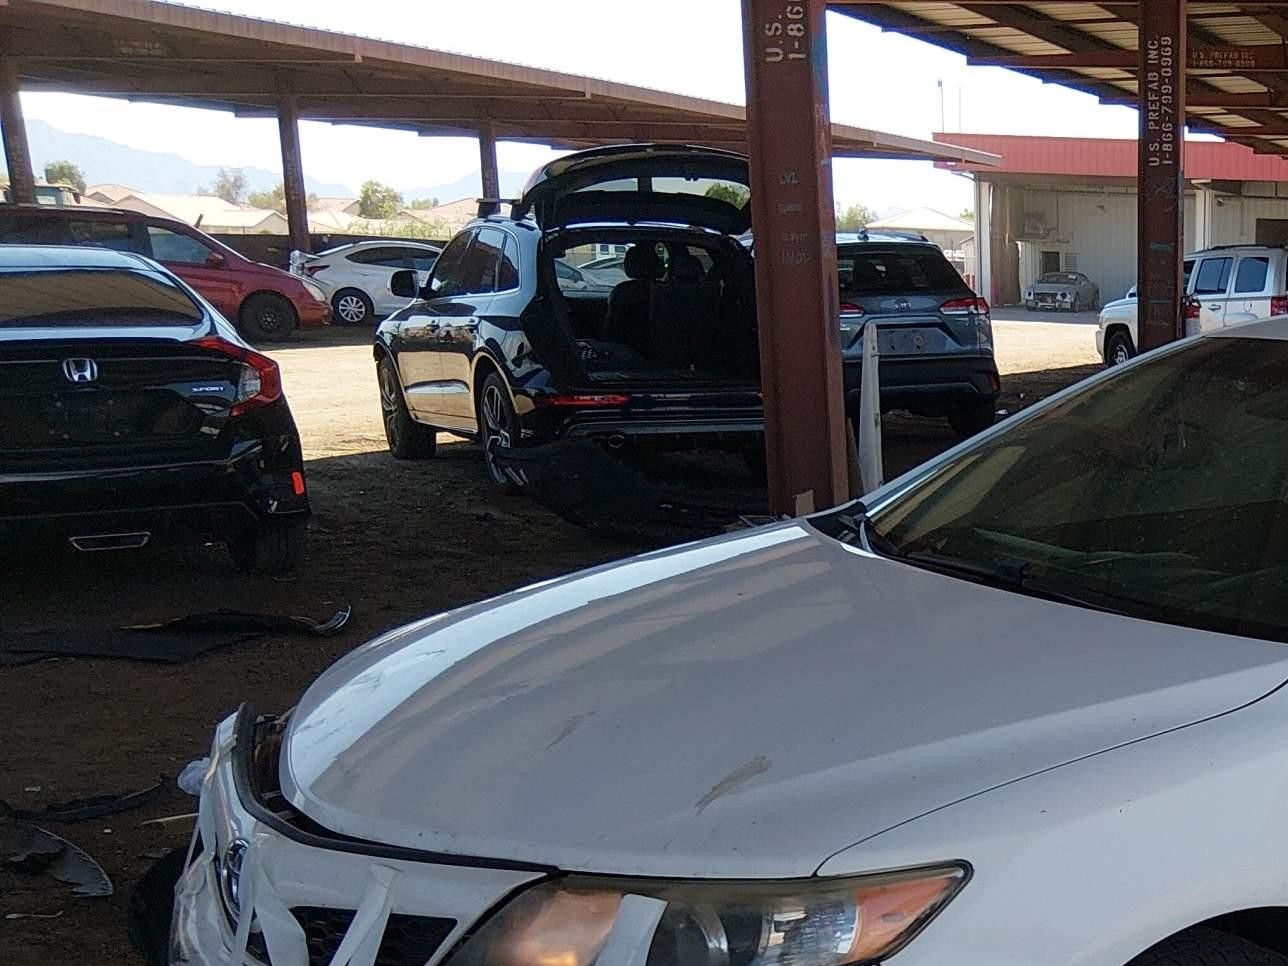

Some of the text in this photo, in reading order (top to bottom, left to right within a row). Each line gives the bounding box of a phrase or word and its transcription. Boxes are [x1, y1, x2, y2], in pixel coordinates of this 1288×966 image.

[765, 14, 783, 62] U.S.
[786, 0, 806, 60] 1-86
[1147, 35, 1160, 166] U.S. PREFAB INC.
[1161, 36, 1173, 165] 1-866-799-0969
